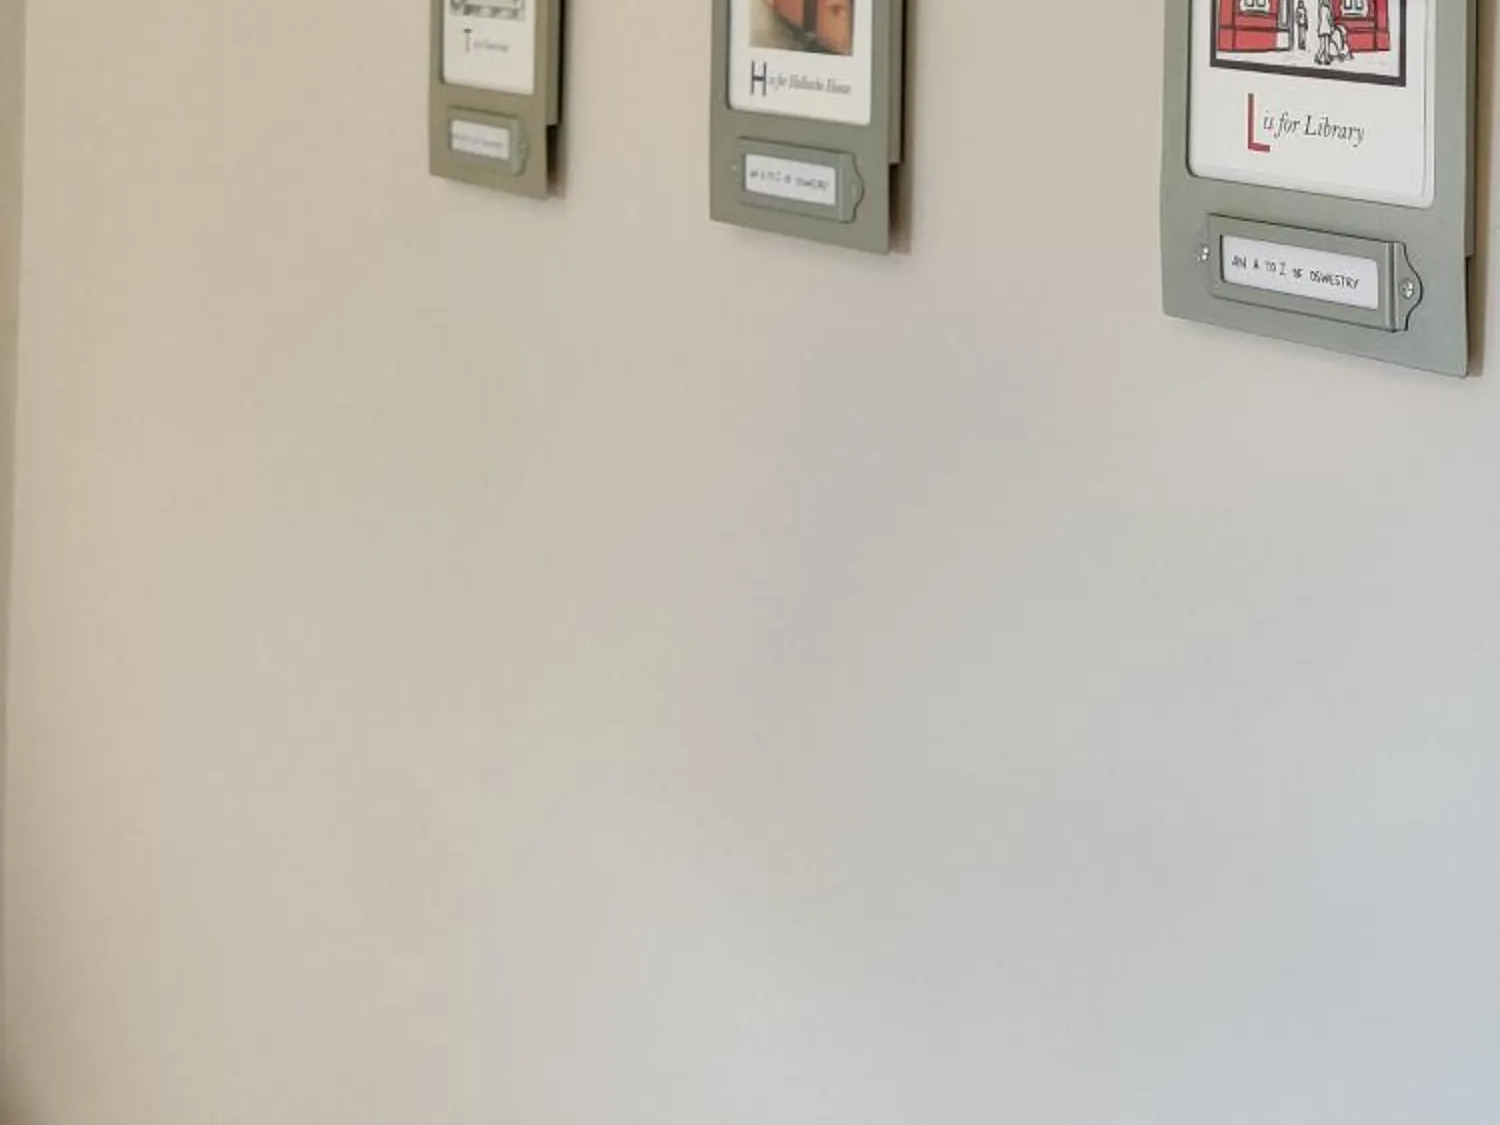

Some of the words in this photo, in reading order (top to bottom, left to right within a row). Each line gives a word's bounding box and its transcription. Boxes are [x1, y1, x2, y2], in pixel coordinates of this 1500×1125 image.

[750, 60, 767, 97] H
[1247, 93, 1271, 152] L
[1263, 110, 1275, 130] is
[1274, 112, 1300, 138] for
[1303, 114, 1365, 147] Library
[1309, 270, 1360, 290] OSWESTRY
